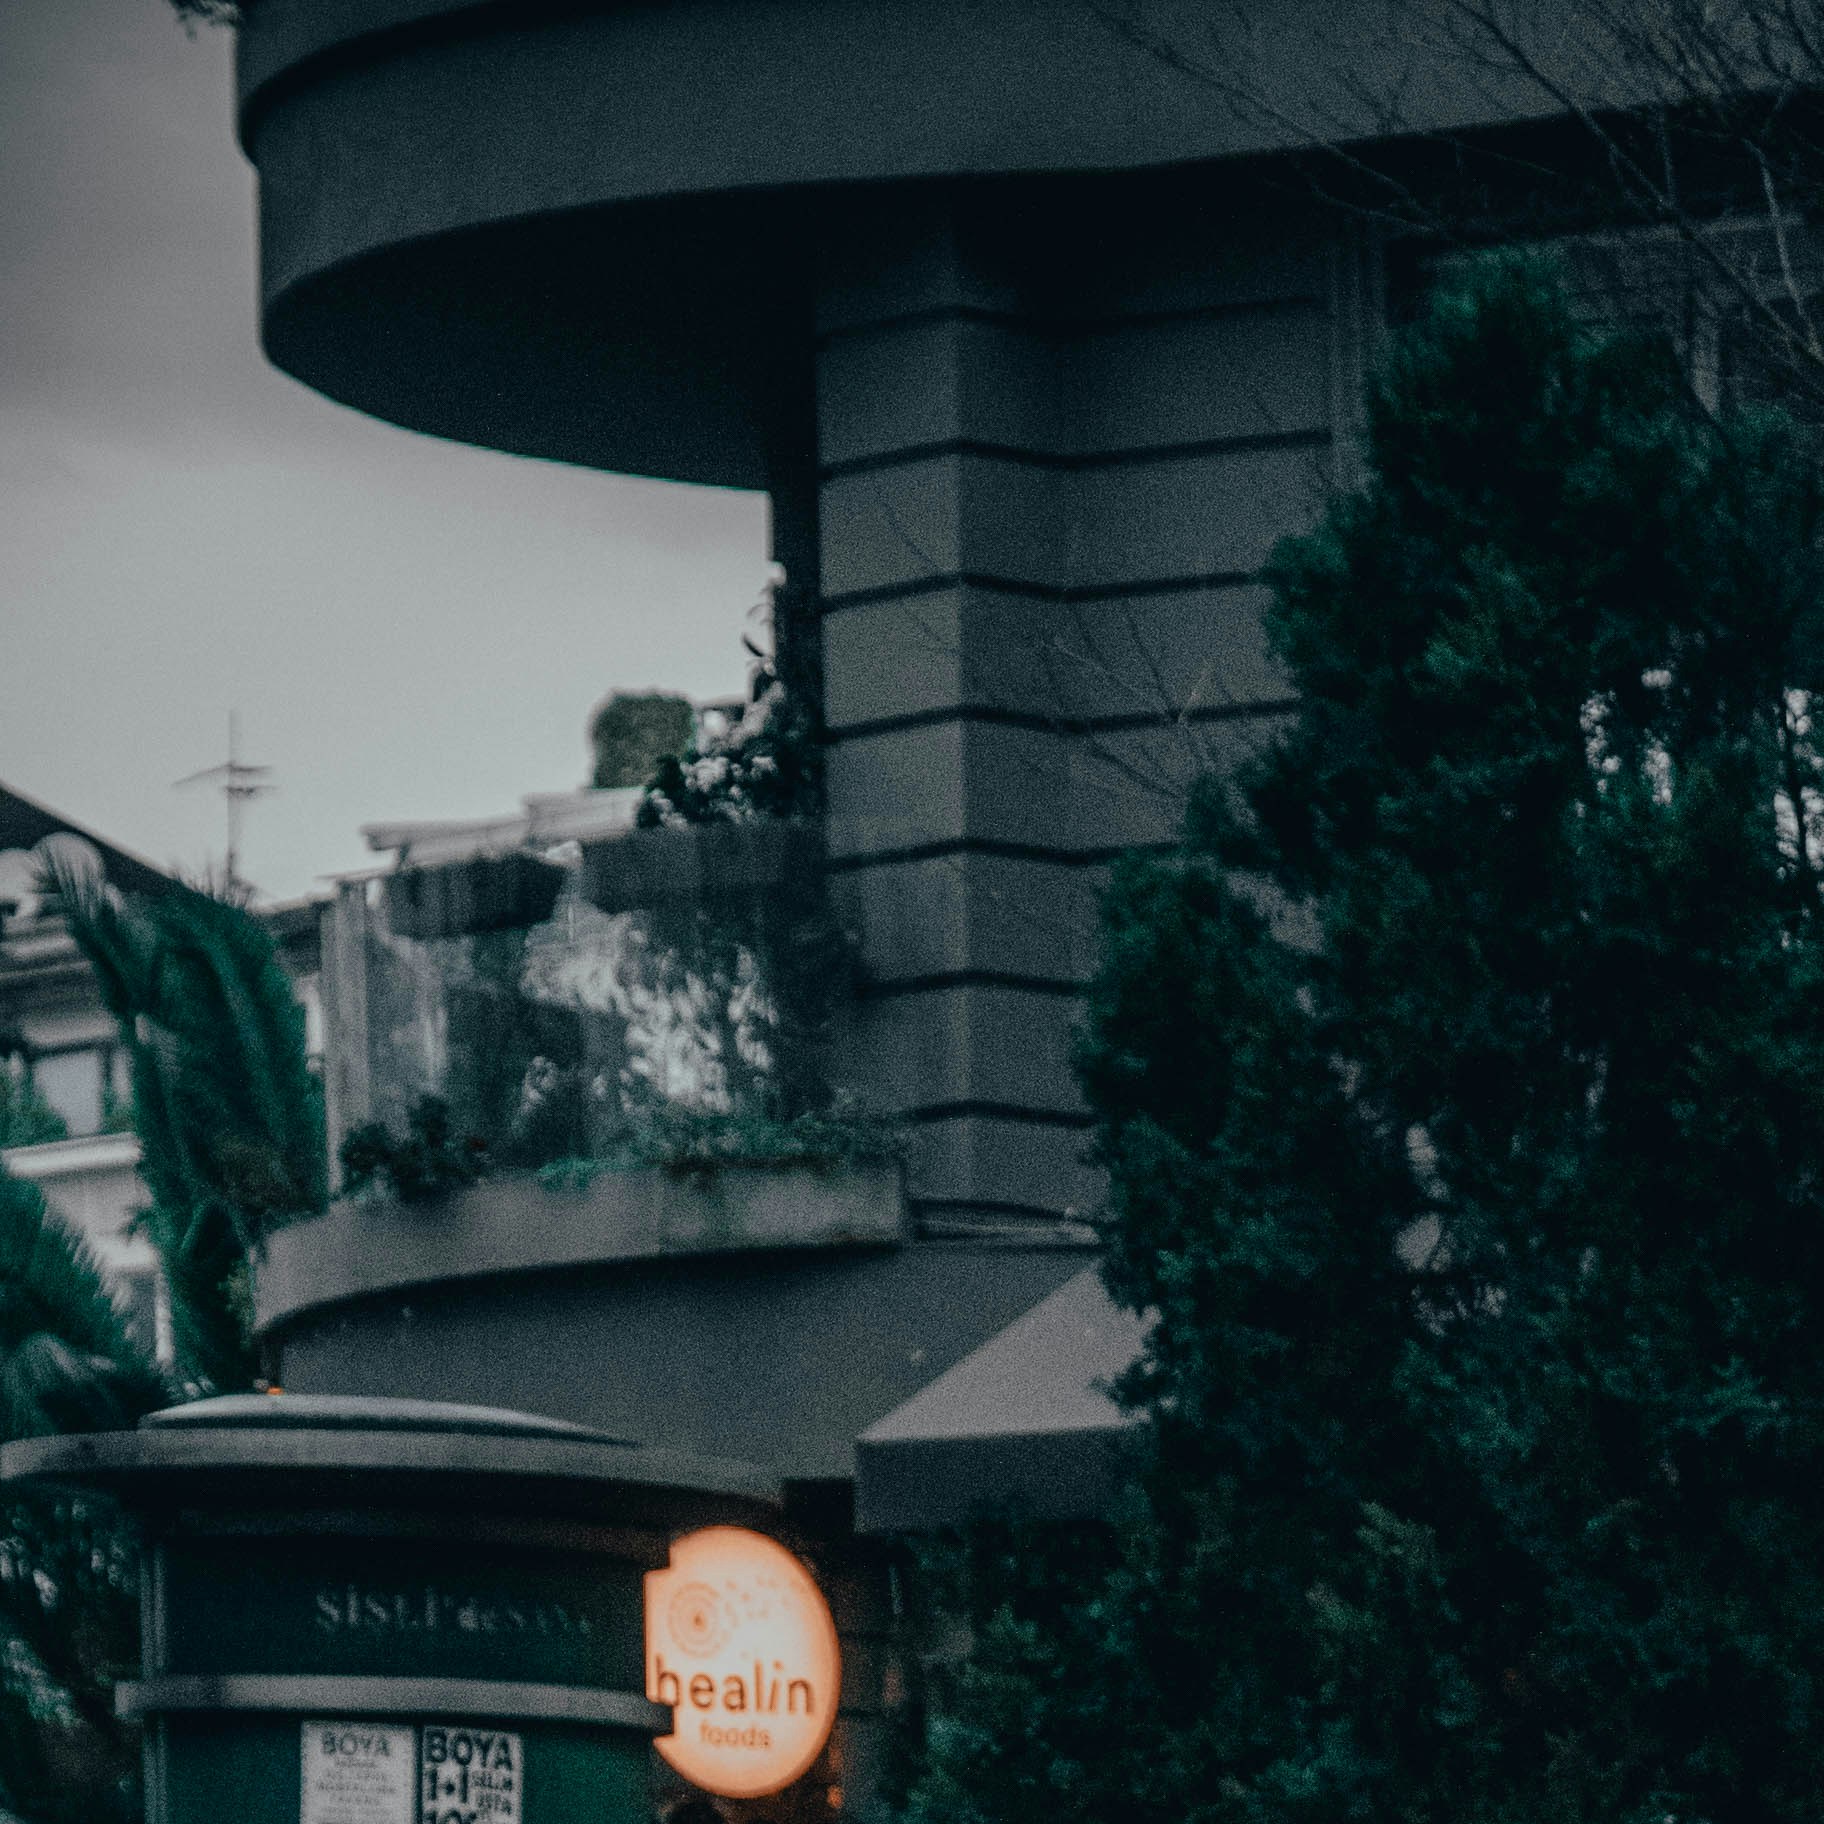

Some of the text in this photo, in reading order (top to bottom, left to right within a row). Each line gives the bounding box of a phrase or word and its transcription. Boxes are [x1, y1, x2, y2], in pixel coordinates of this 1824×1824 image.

[656, 1654, 816, 1714] healin
[321, 1731, 390, 1757] BOYA
[426, 1729, 512, 1770] BOYA
[700, 1719, 771, 1748] foods
